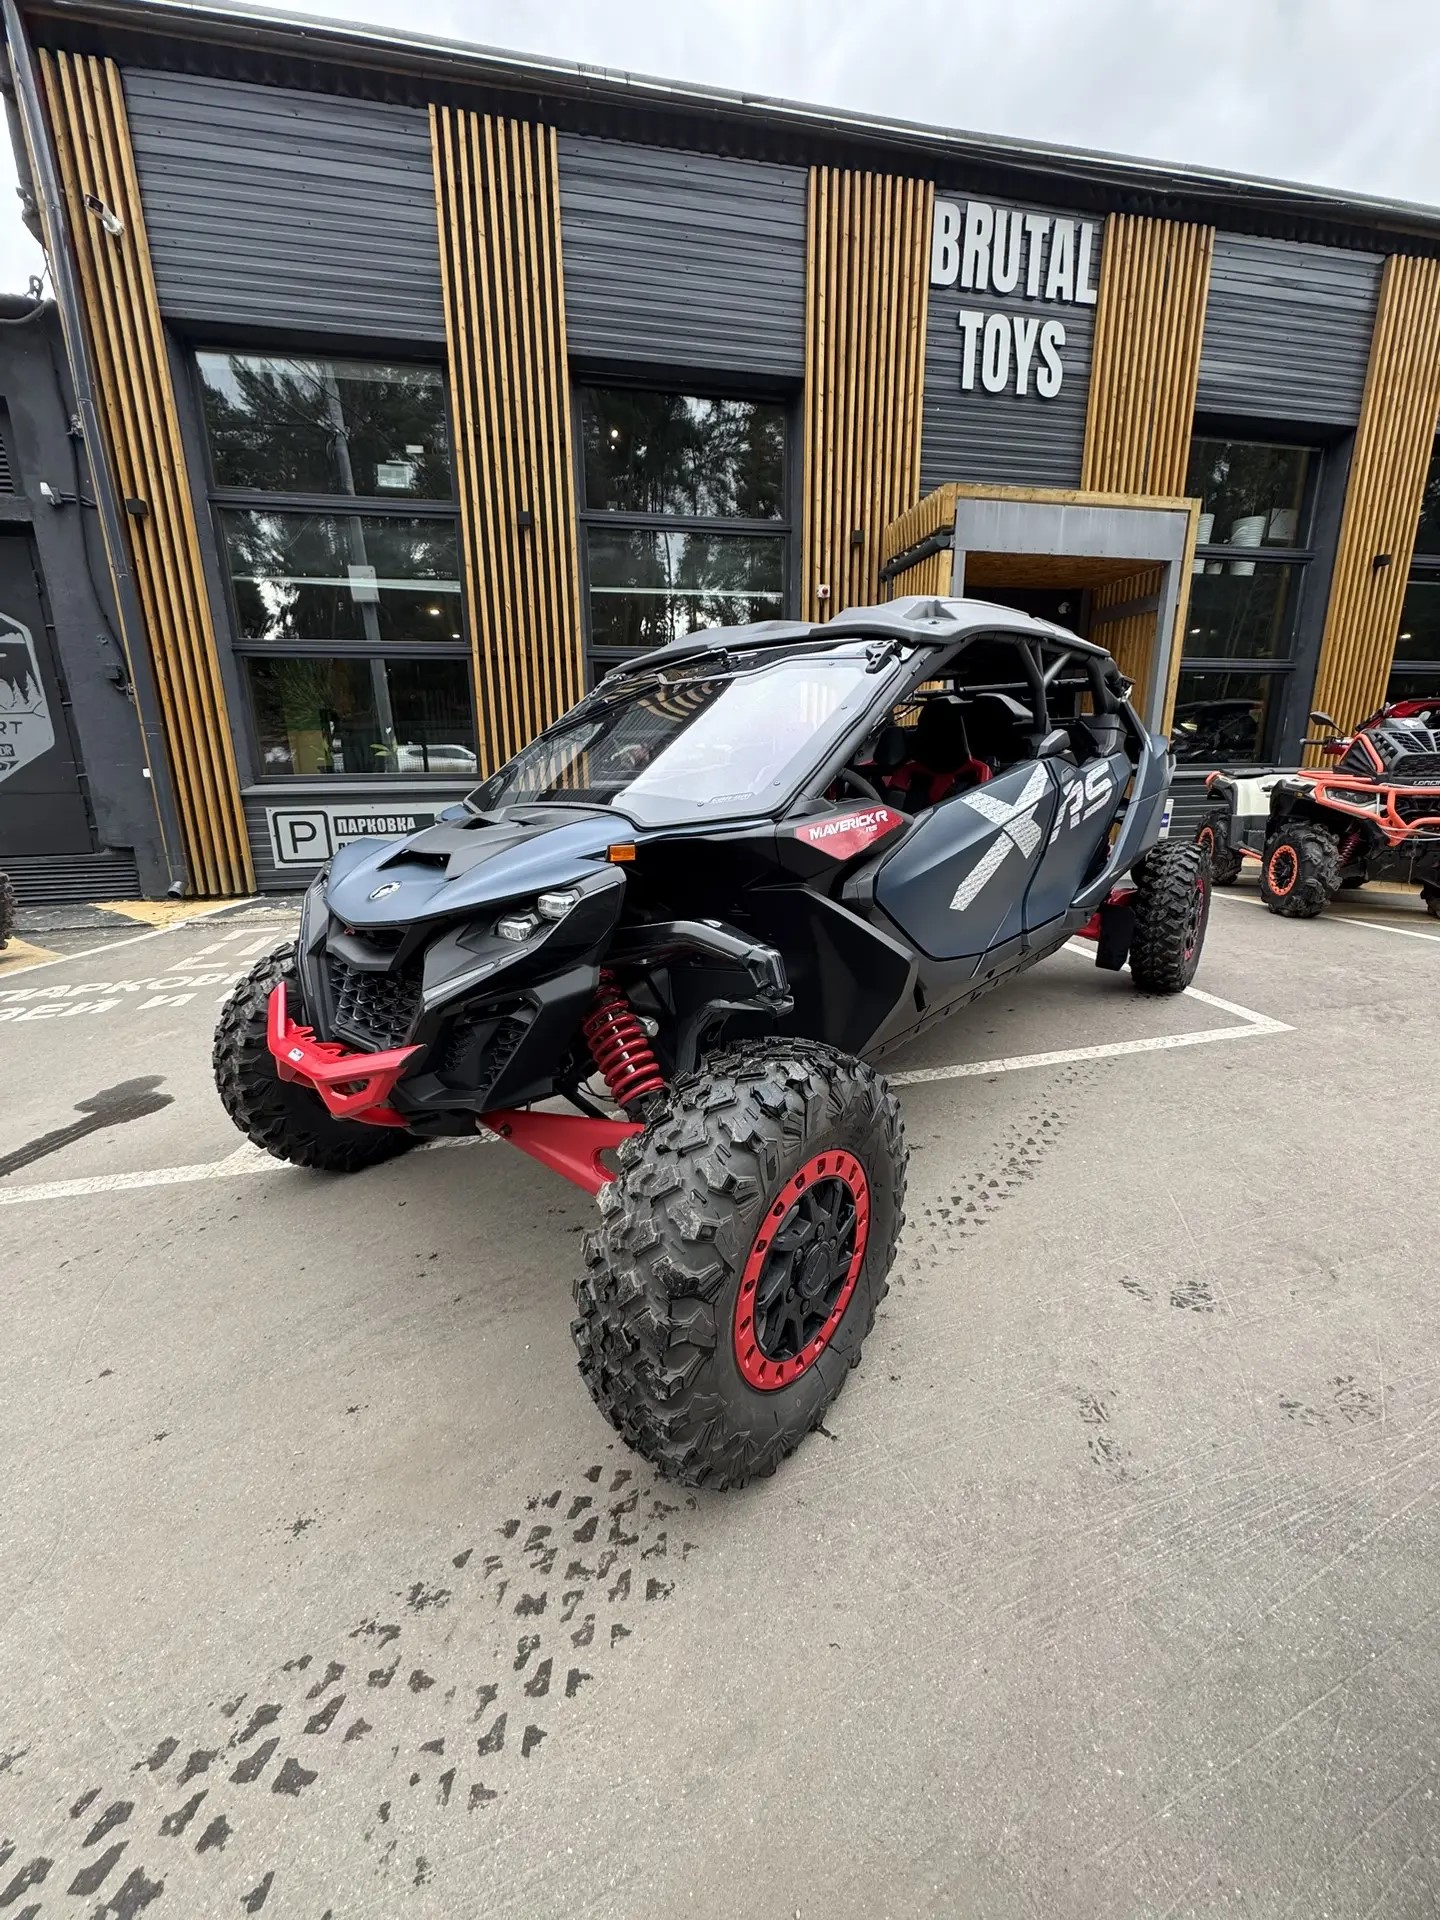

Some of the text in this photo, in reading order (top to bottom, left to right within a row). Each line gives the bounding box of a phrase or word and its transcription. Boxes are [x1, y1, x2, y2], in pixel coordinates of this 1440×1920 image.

[931, 201, 1097, 304] BRUTAL
[959, 310, 1066, 398] TOYS
[336, 816, 416, 834] ПАРКОВКА
[808, 809, 888, 840] MAVERICK R
